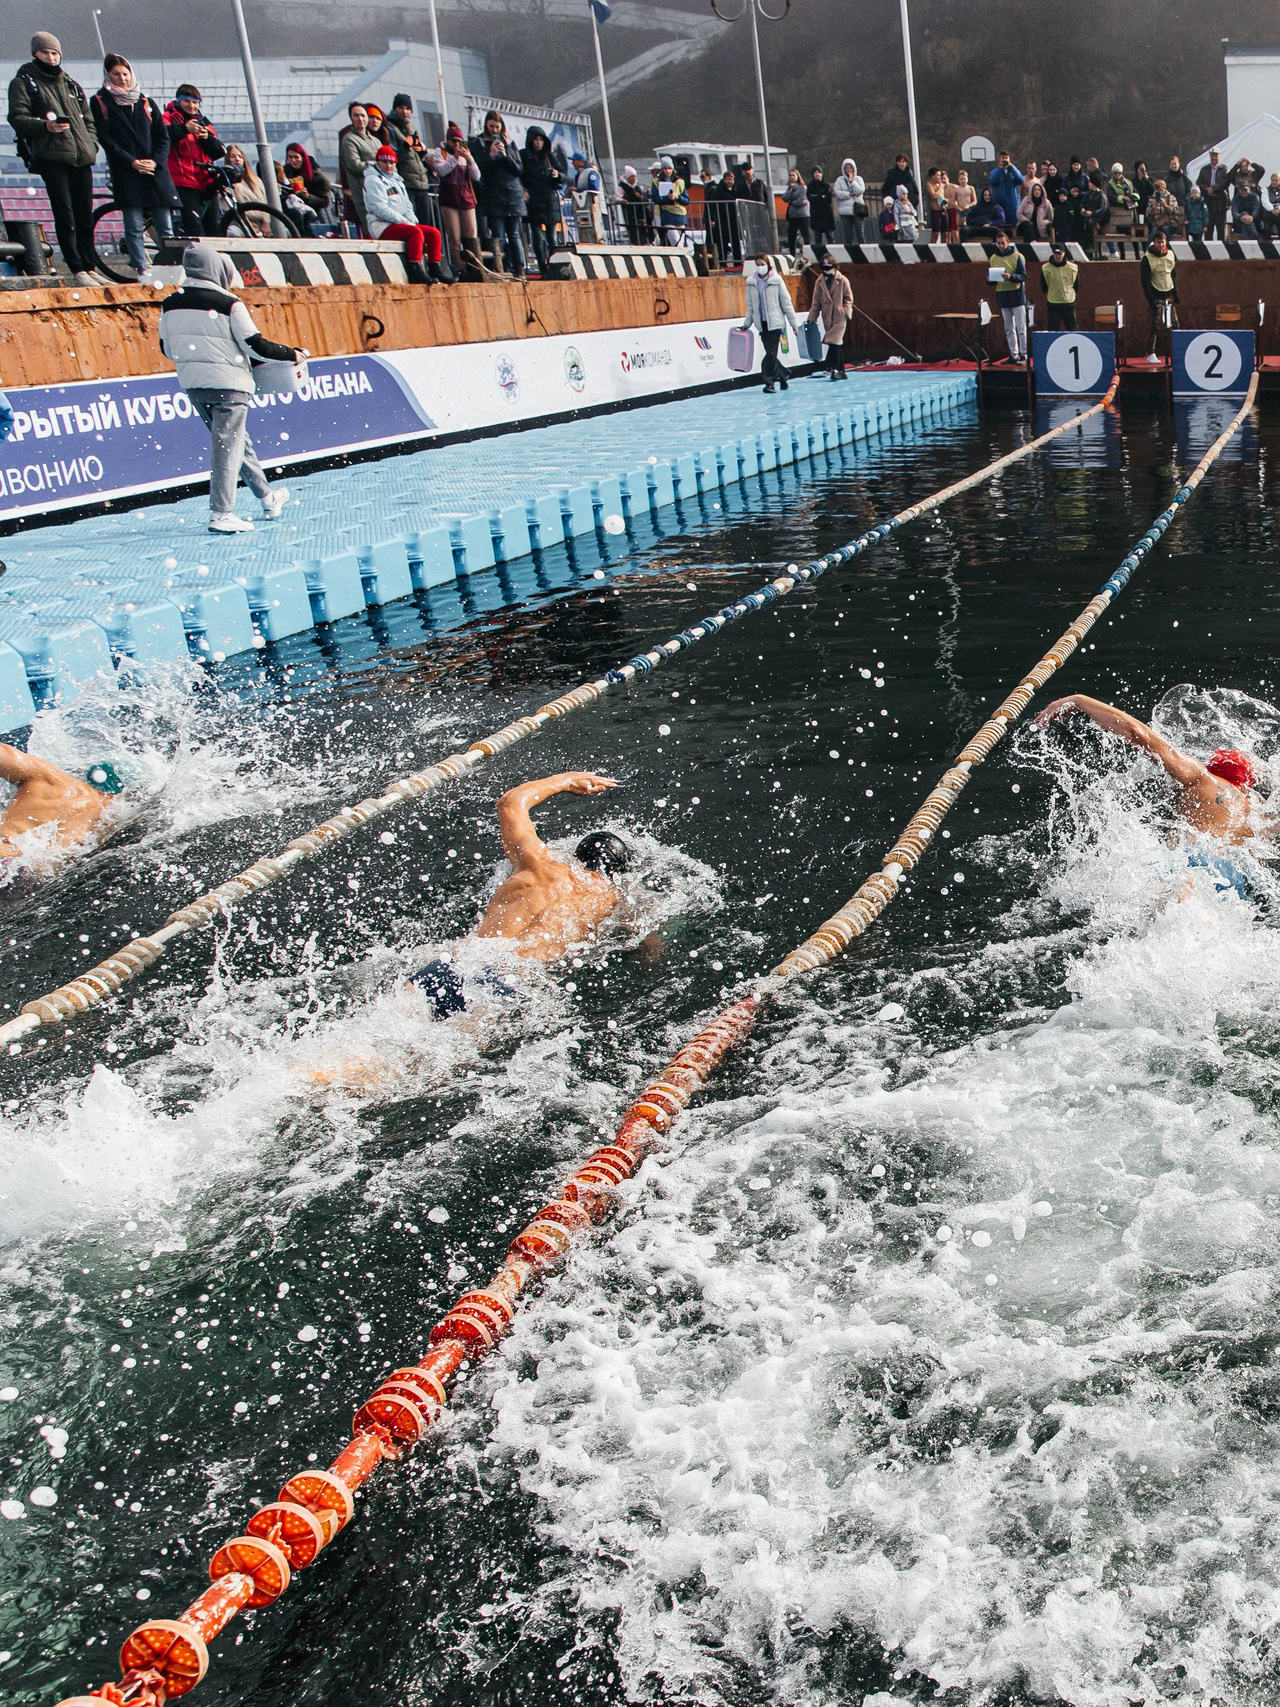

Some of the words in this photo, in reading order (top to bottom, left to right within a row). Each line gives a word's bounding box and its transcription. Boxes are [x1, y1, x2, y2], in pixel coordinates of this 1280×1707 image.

[1068, 345, 1080, 380] 1
[1203, 344, 1223, 379] 2
[301, 370, 373, 402] ОКЕАНА
